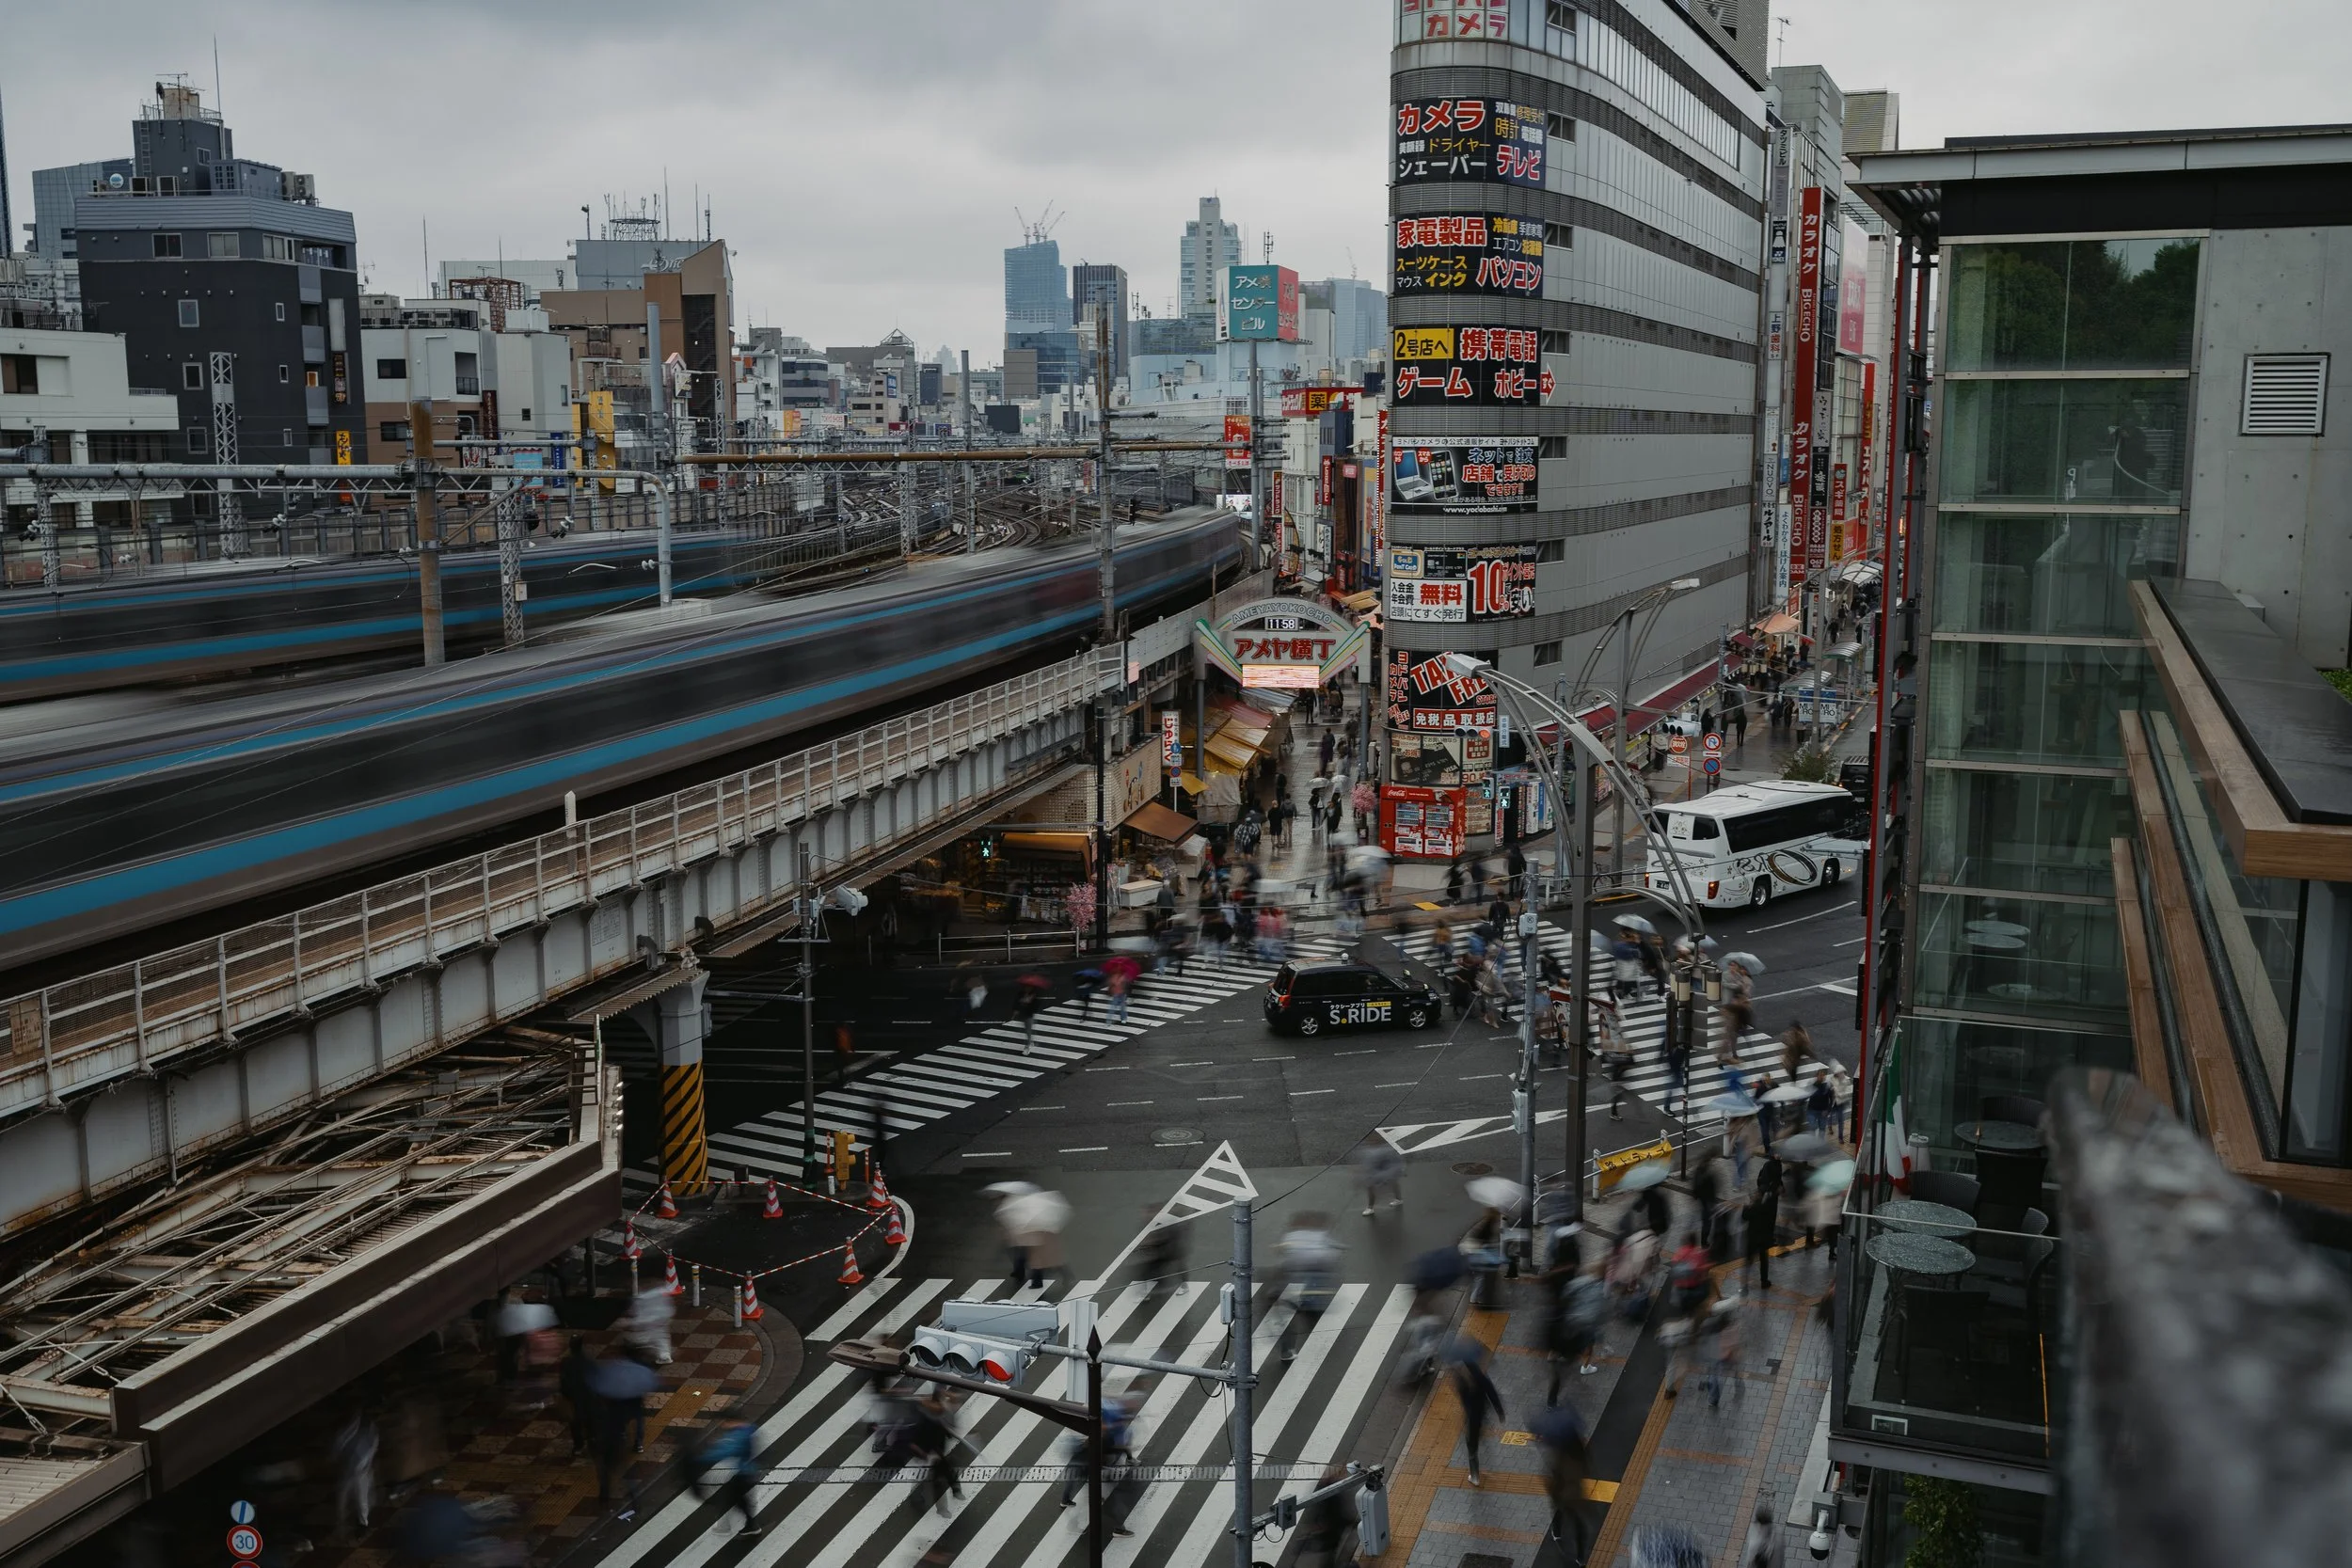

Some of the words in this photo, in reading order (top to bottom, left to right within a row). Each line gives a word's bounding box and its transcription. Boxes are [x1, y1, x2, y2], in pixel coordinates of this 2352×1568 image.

[1426, 12, 1507, 38] カメラ
[1397, 100, 1486, 135] カメラ
[1495, 118, 1519, 140] 時計
[1429, 138, 1491, 153] ドライヤー
[1399, 154, 1487, 178] シェーバー
[1497, 144, 1541, 181] テレビ
[1397, 216, 1487, 248] 家電製品
[1492, 237, 1522, 252] エアコン
[1803, 214, 1818, 275] カラオケ
[1396, 255, 1468, 272] スーツケース
[1475, 255, 1542, 291] パソコン
[1396, 276, 1422, 288] マウス
[1425, 272, 1467, 288] インク
[1232, 297, 1276, 310] センター
[1802, 288, 1813, 309] BIG
[1242, 317, 1265, 330] ビル
[1800, 311, 1811, 342] ECHO
[1396, 332, 1448, 358] 2号店へ
[1460, 327, 1537, 363] 携帯電話
[1396, 366, 1473, 399] ゲーム
[1494, 368, 1536, 399] ホビー
[1311, 393, 1326, 408] 薬
[1793, 421, 1809, 480] カラオケ
[1793, 495, 1804, 515] BIG
[1791, 516, 1803, 546] ECHO
[1391, 582, 1414, 593] 入会金
[1420, 583, 1463, 606] 無料
[1391, 594, 1414, 606] 年会費
[1232, 603, 1332, 625] AMEYAYOKOCHO
[1391, 607, 1464, 620] 店頭にてすぐ発行
[1233, 638, 1336, 659] アメヤ横丁
[1397, 651, 1408, 703] ヨドバシ
[1448, 671, 1490, 705] FRE
[1416, 711, 1494, 727] 免税品取扱店
[1329, 1006, 1391, 1025] S.RIDE
[235, 1534, 255, 1550] 30
